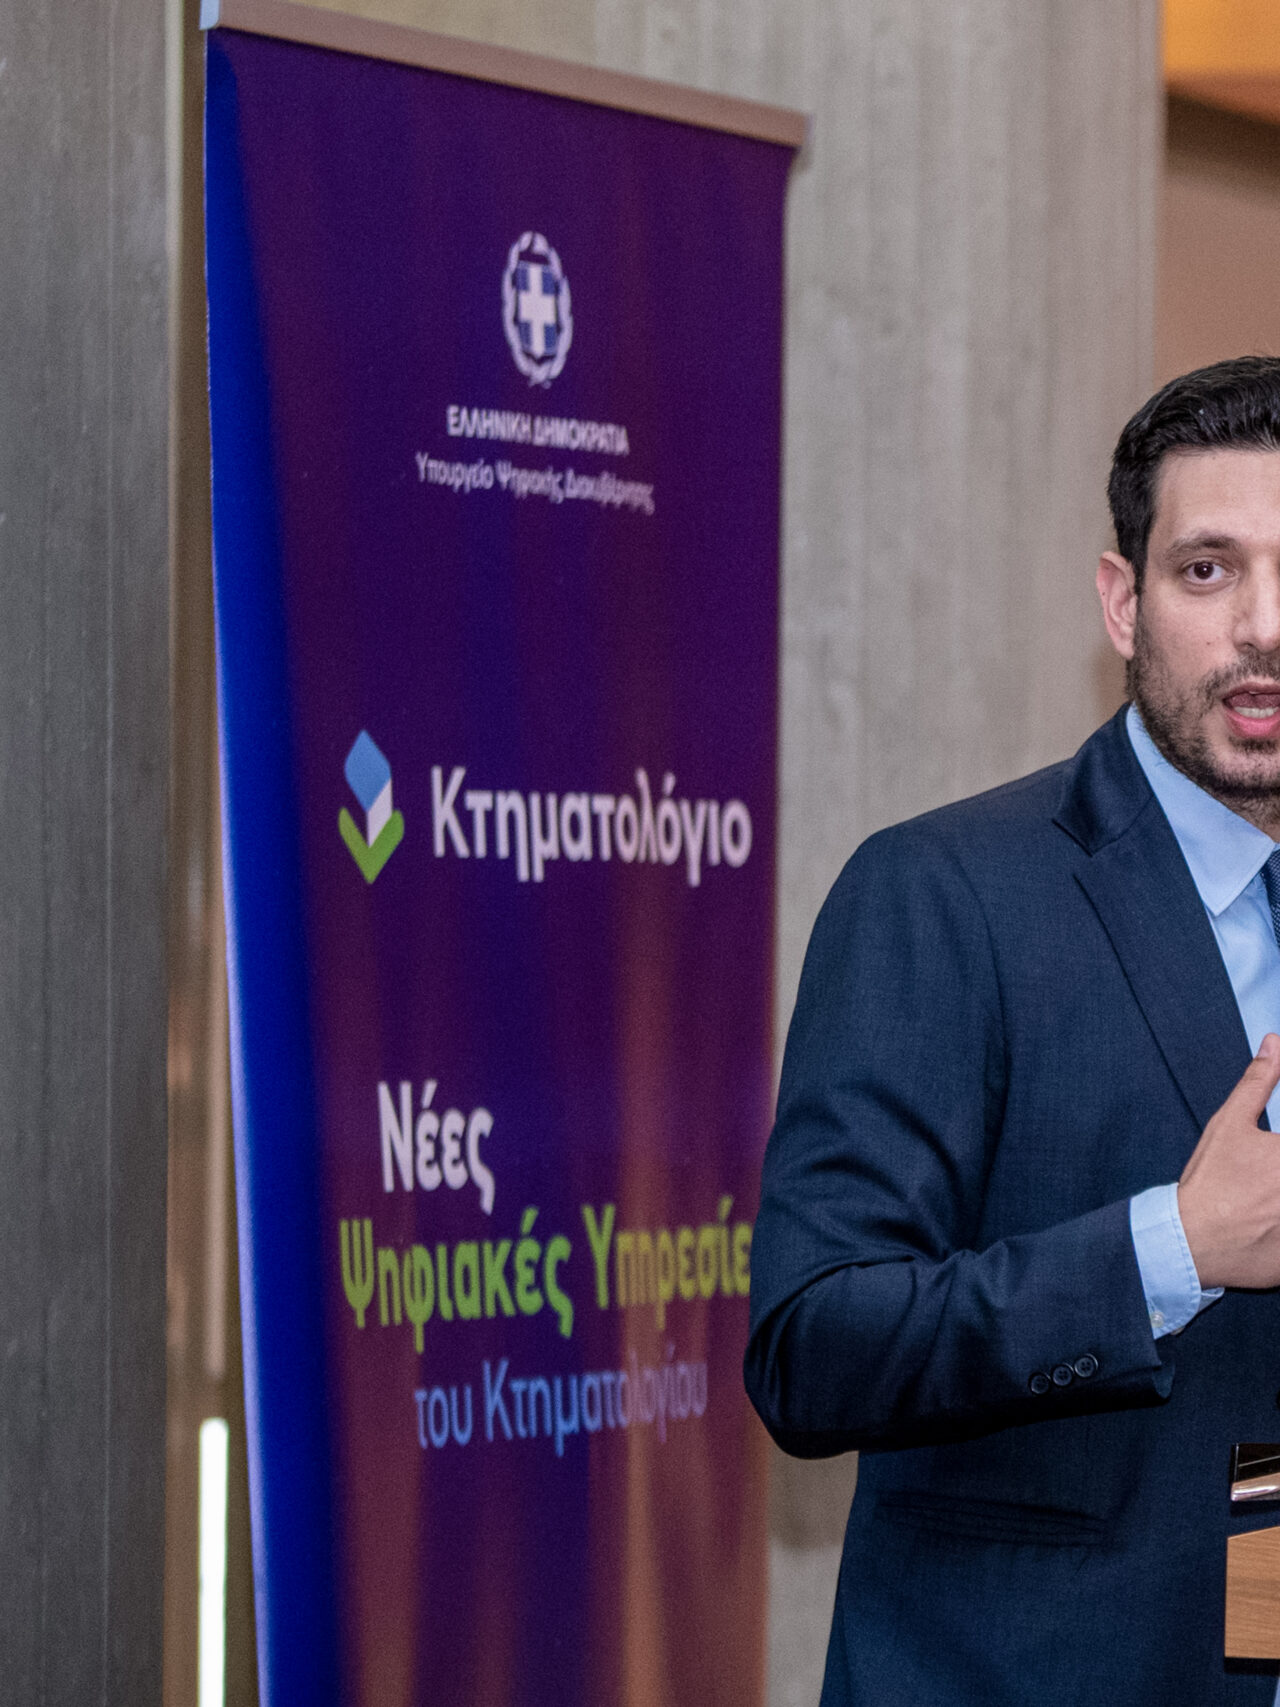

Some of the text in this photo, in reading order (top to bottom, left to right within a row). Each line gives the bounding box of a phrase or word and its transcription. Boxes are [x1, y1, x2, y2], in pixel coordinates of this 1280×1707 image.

[415, 451, 494, 493] Υπουργείο
[446, 404, 630, 456] ΕΛΛΗΝΙΚΗ ΔΗΜΟΚΡΑΤΙΑ
[431, 765, 753, 888] Κτηματολόγιο
[377, 1078, 495, 1215] Νέες
[339, 1194, 753, 1355] Ψηφιακές Υπηρεσίε
[414, 1343, 709, 1458] του Κτηματολογίου
